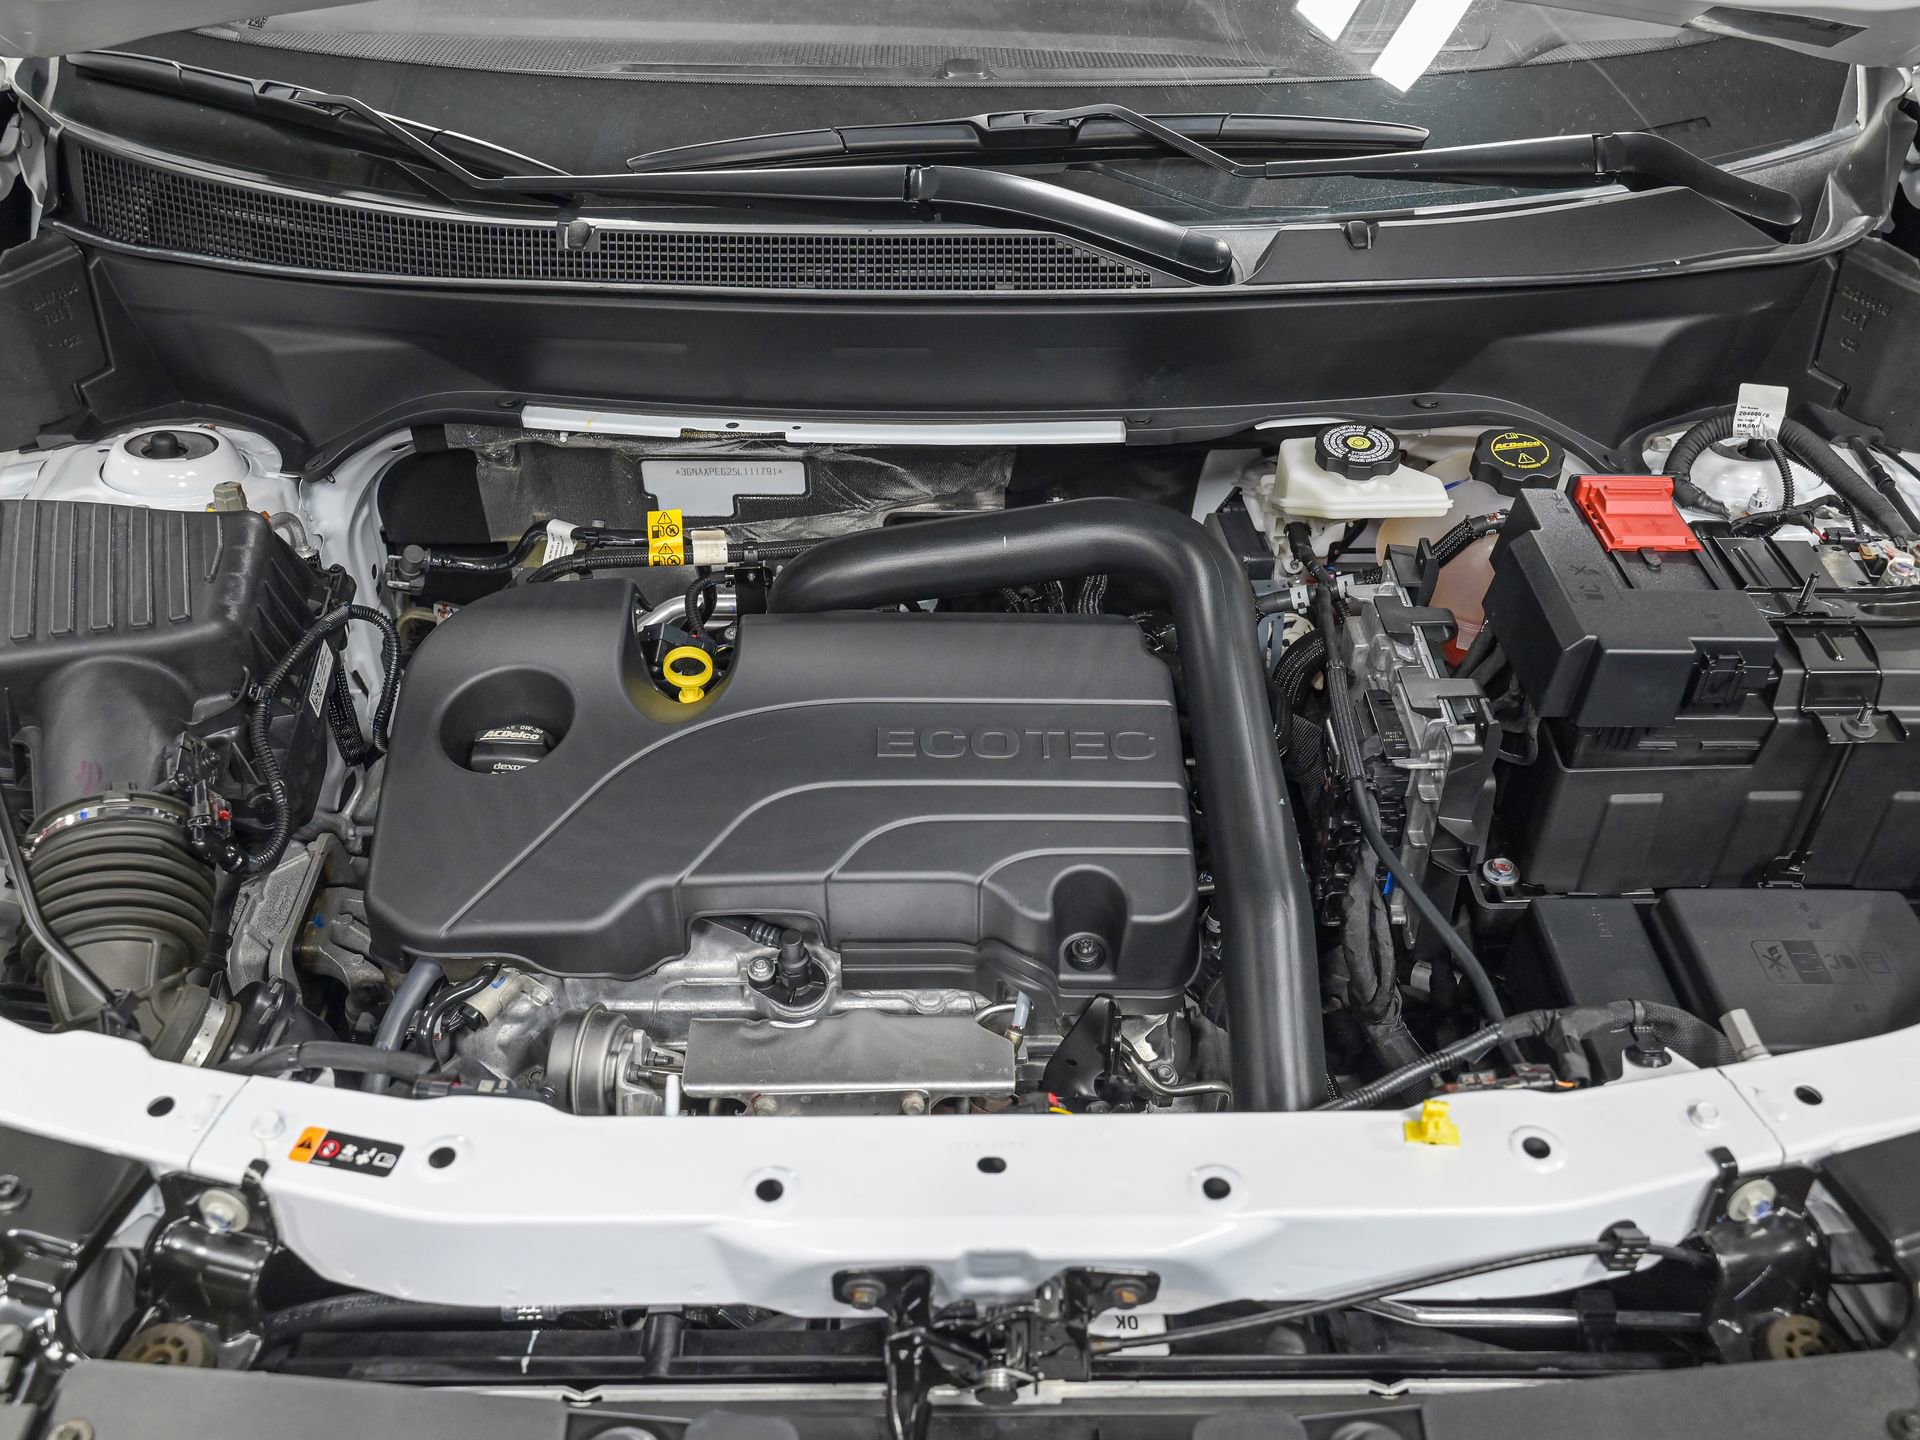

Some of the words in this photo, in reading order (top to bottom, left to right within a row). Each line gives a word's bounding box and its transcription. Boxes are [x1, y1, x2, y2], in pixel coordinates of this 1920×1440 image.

[483, 730, 540, 740] ACDelco
[877, 727, 1157, 760] ECOTEC
[1115, 1315, 1138, 1330] OK
